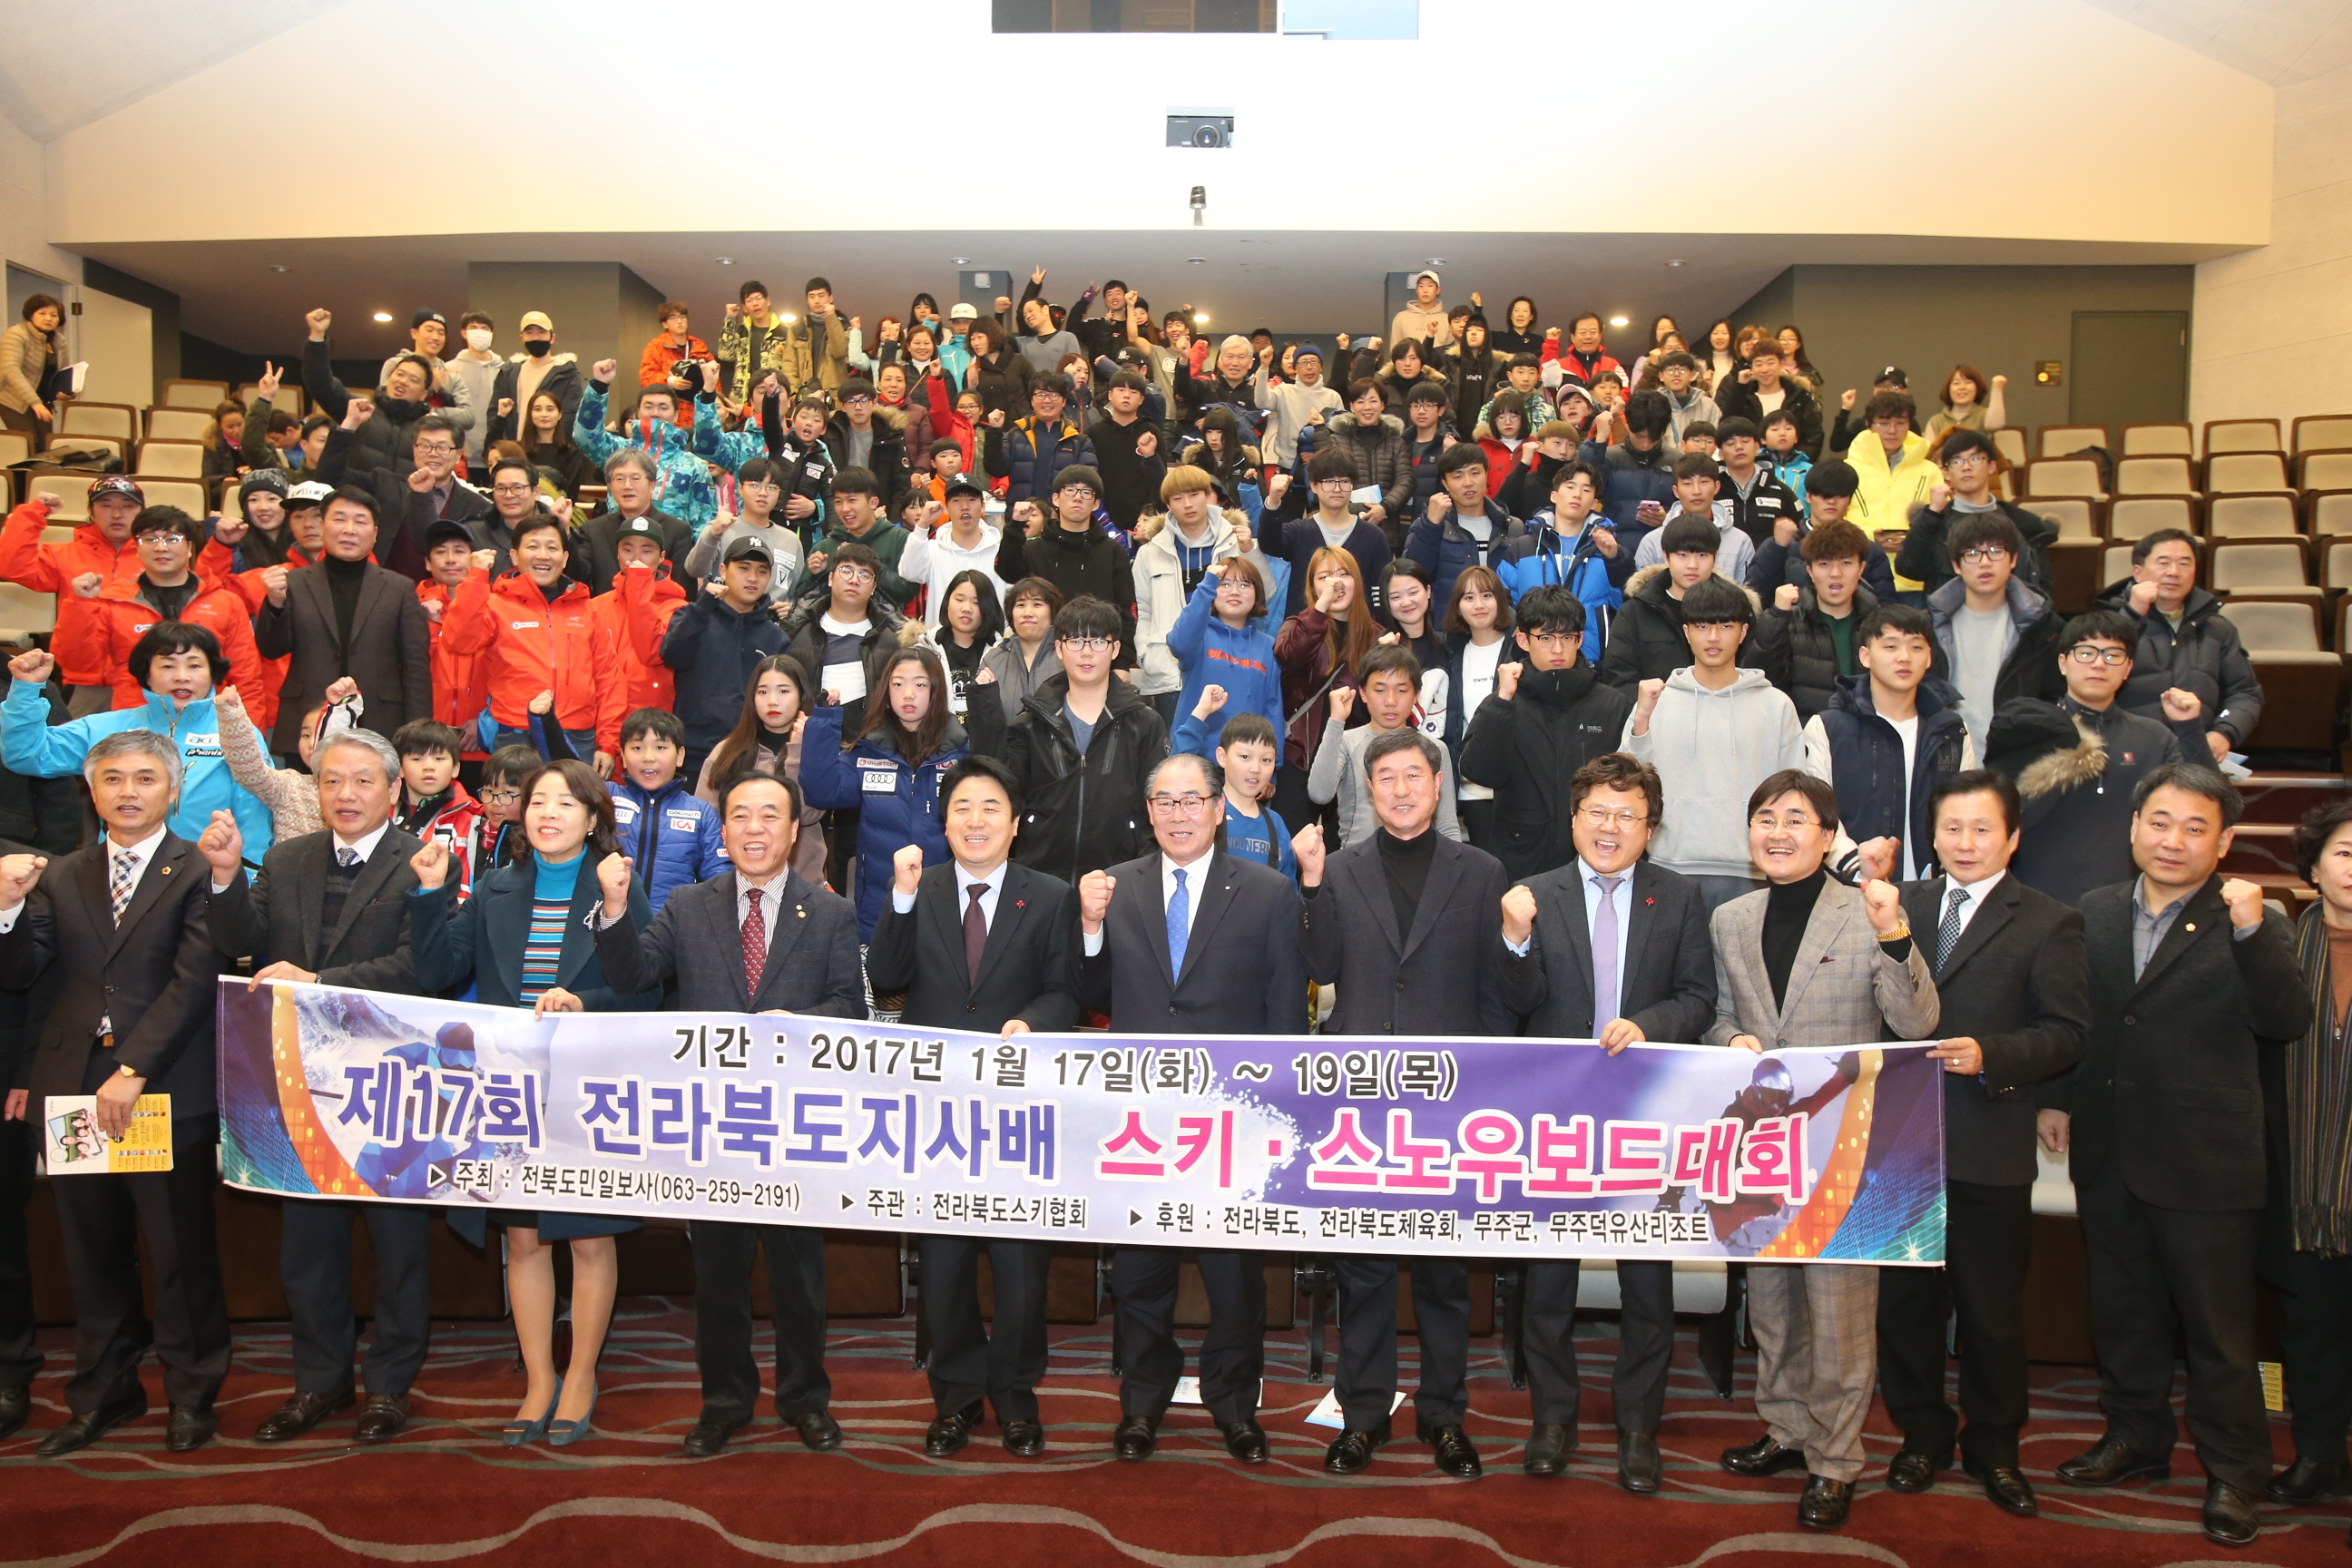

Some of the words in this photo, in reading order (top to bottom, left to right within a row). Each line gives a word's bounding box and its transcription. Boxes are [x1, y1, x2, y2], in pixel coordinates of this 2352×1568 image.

[1885, 366, 1895, 375] P
[672, 819, 692, 830] ICA
[673, 1025, 750, 1069] 기간
[811, 1034, 944, 1083] 2017년
[972, 1045, 1027, 1087] 1월
[1054, 1049, 1212, 1094] 17일(화)
[1296, 1053, 1456, 1097] 19일(목)
[338, 1062, 542, 1149] 제17회
[582, 1080, 1055, 1180] 전라북도지사배
[1101, 1111, 1233, 1188] 스키
[456, 1165, 494, 1191] 주최
[522, 1167, 800, 1212] 전북도민일보사(063-259-2191)
[867, 1190, 905, 1215] 주관
[933, 1193, 1086, 1228] 전라북도스키협회
[1156, 1202, 1194, 1232] 후원
[1223, 1207, 1307, 1238] 전라북도,
[1319, 1210, 1462, 1241] 전라북도체육회,
[1474, 1212, 1538, 1243] 무주군,
[1550, 1212, 1709, 1244] 무주덕유산리조트
